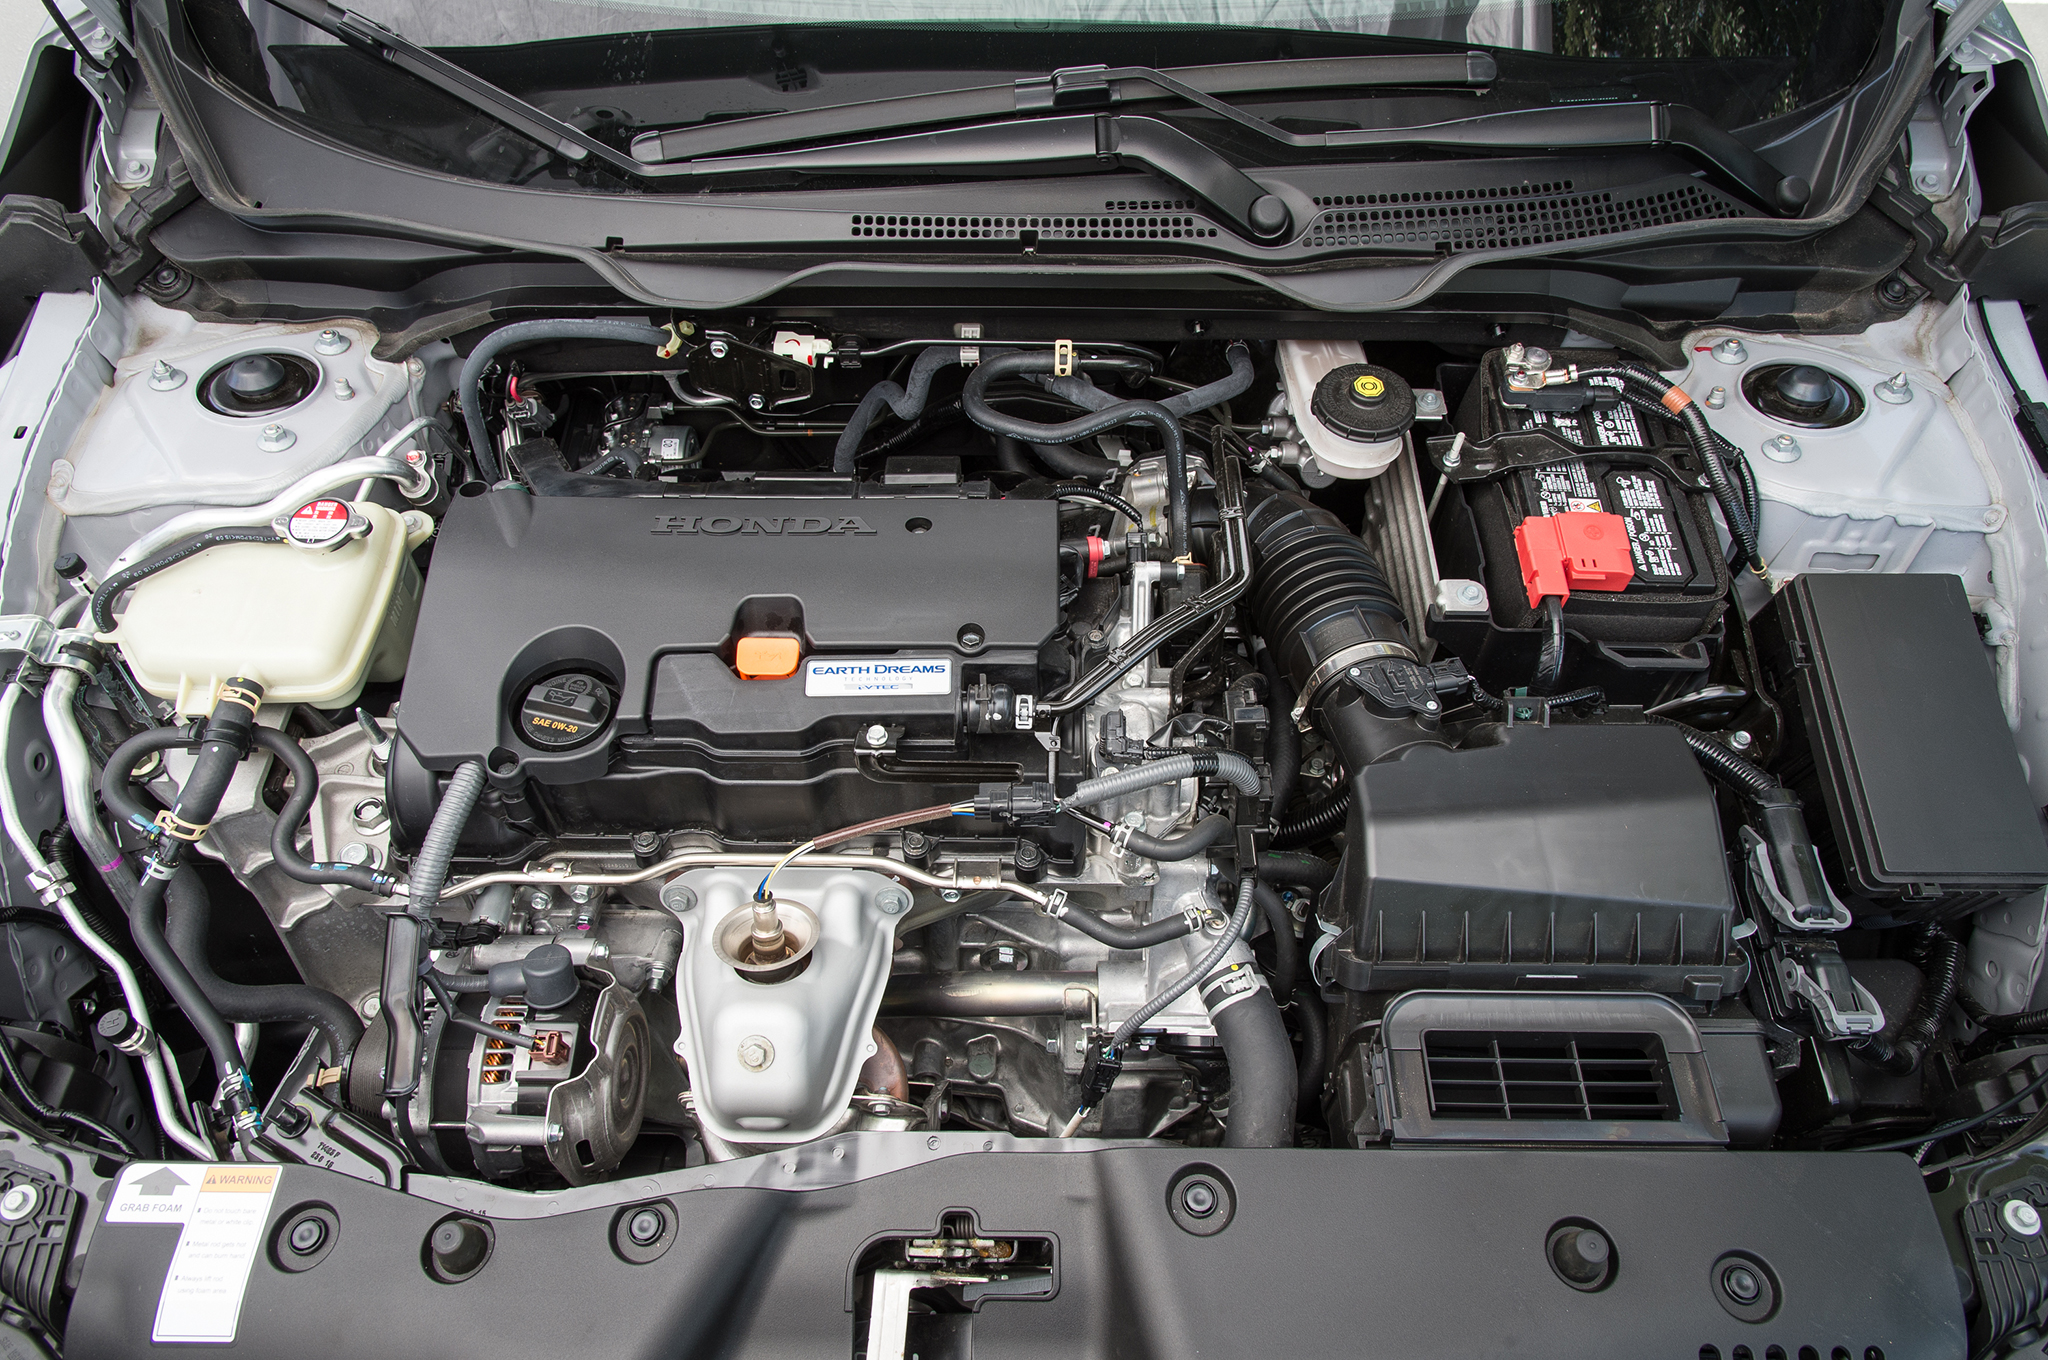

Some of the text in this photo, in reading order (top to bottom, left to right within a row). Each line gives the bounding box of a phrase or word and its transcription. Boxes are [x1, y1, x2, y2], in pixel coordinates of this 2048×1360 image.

[650, 515, 878, 537] HONDA
[812, 664, 946, 675] EARTH DREAMS
[532, 717, 579, 734] SAE 0W-20
[219, 1175, 273, 1185] WARNING
[119, 1203, 183, 1212] GRAB FOAM
